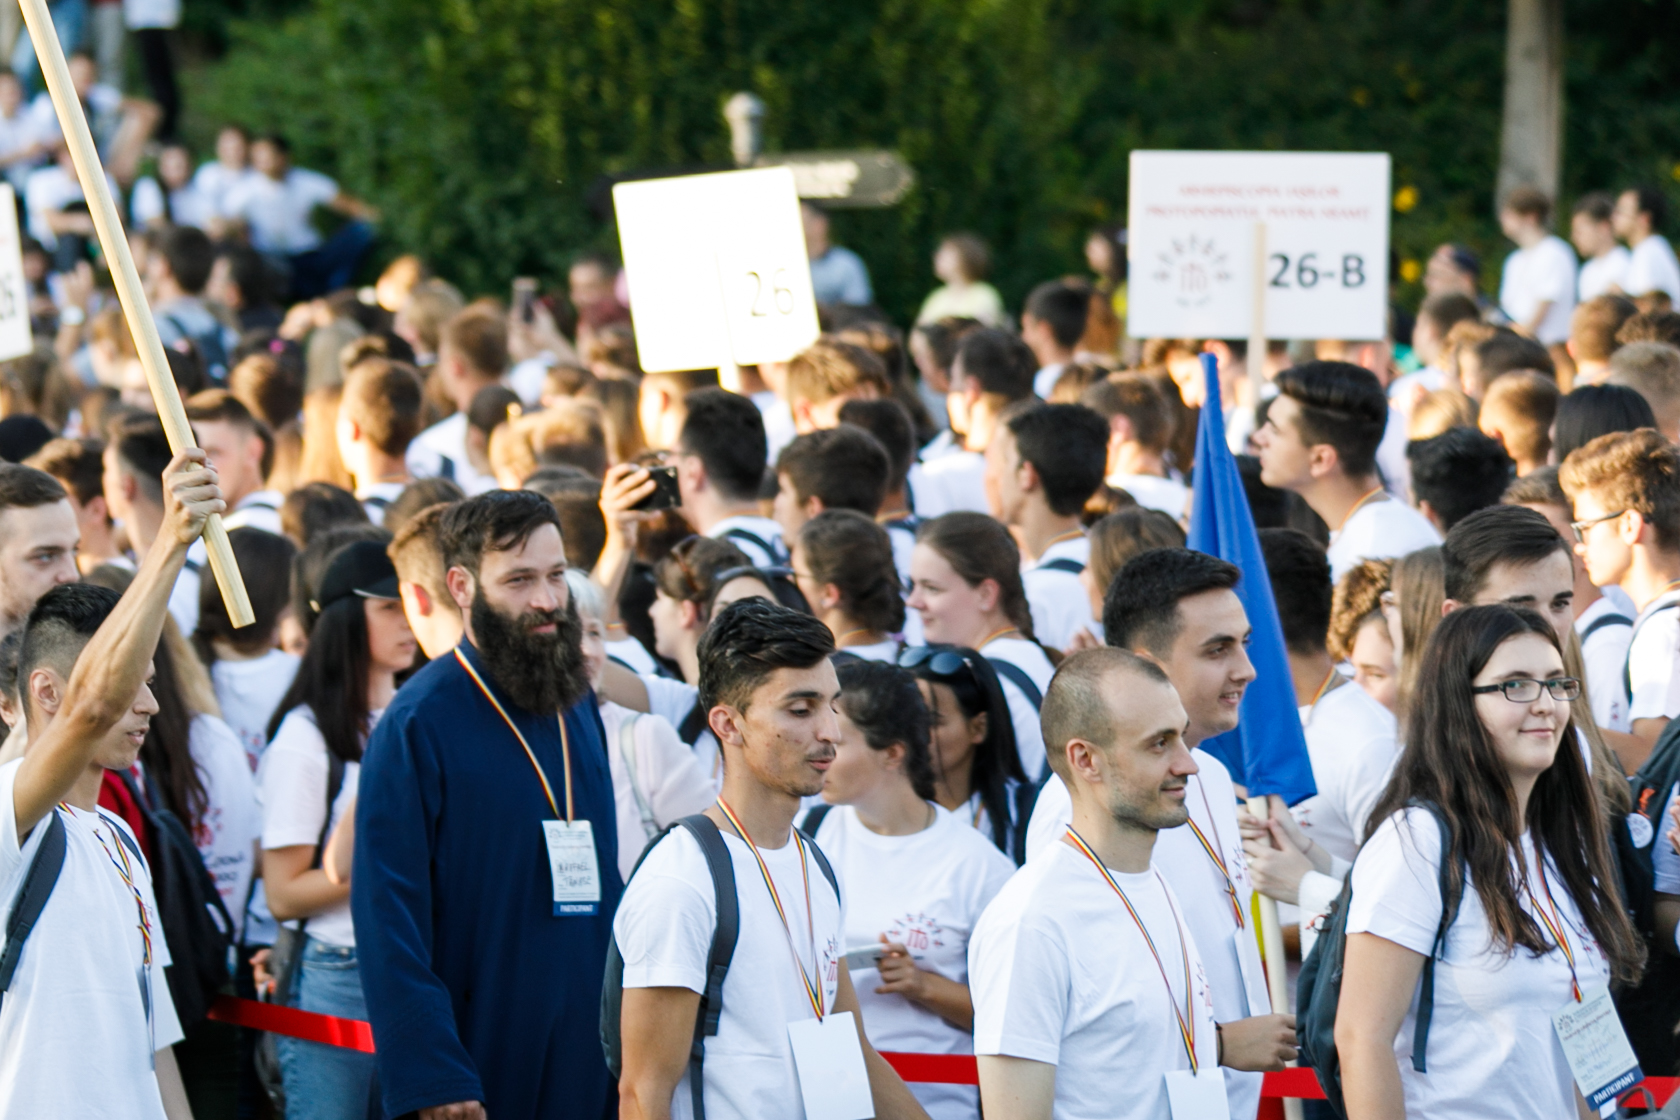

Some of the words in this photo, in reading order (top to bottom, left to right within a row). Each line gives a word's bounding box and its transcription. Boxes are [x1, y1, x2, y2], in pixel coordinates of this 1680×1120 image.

[1269, 253, 1365, 288] 26-B
[747, 268, 794, 316] 26
[1592, 1072, 1635, 1105] PARTICIPANT
